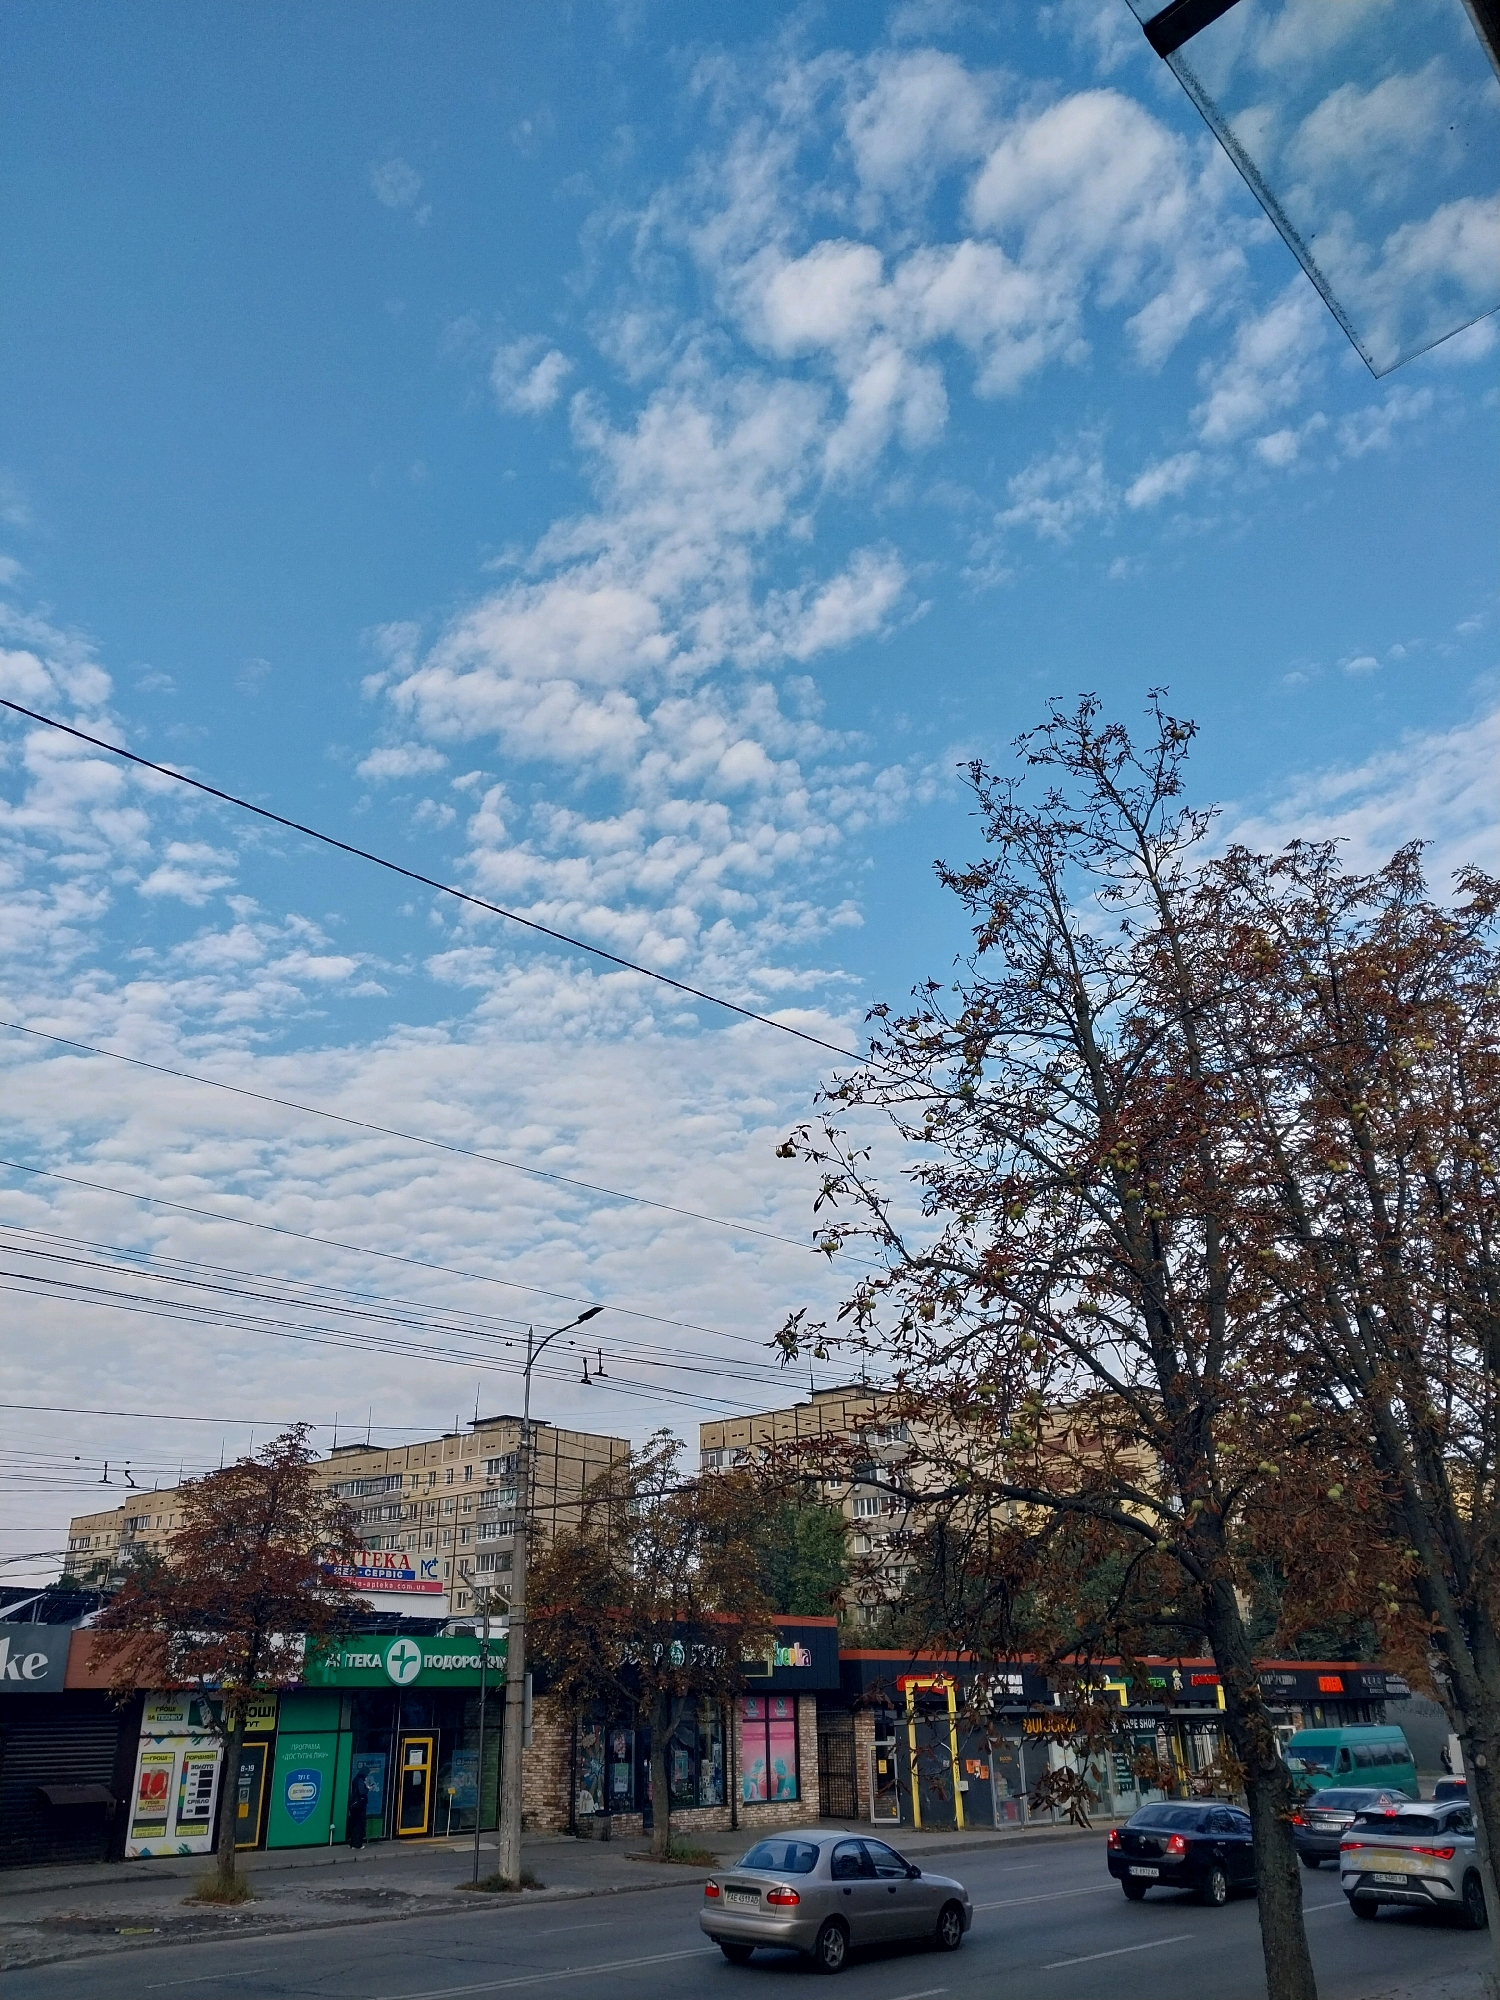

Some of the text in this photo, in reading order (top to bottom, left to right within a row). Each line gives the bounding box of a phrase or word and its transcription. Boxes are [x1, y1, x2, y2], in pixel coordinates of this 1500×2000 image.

[364, 1568, 403, 1579] СЕРВІС
[229, 1706, 276, 1719] ГОШІ
[1139, 1718, 1156, 1728] SHOP
[730, 1893, 738, 1902] AE
